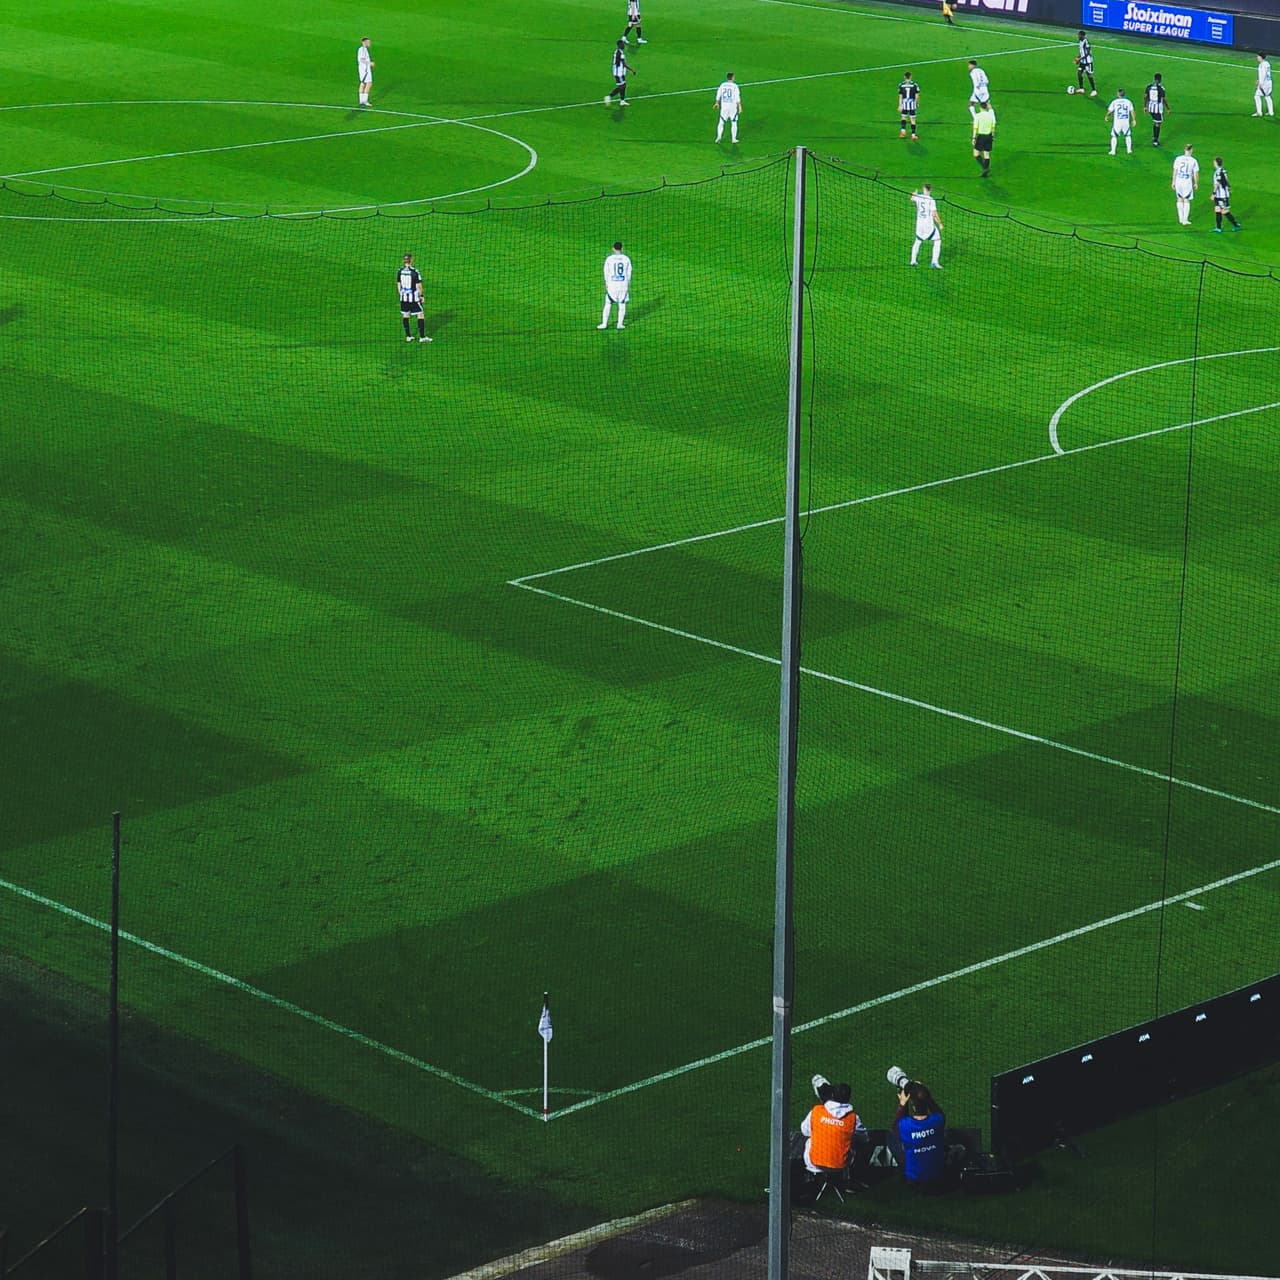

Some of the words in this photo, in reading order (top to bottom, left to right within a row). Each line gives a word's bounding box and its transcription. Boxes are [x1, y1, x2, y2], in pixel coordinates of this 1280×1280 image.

[1124, 2, 1192, 28] Stoiximan
[1123, 20, 1152, 34] SUPER
[1154, 25, 1191, 38] LEAGUE
[722, 87, 732, 99] 20
[1114, 103, 1125, 114] 24
[1179, 162, 1190, 173] 21
[920, 203, 926, 214] 5
[613, 261, 624, 276] 18
[821, 1116, 845, 1128] PHOTO
[911, 1128, 935, 1140] PHOTO
